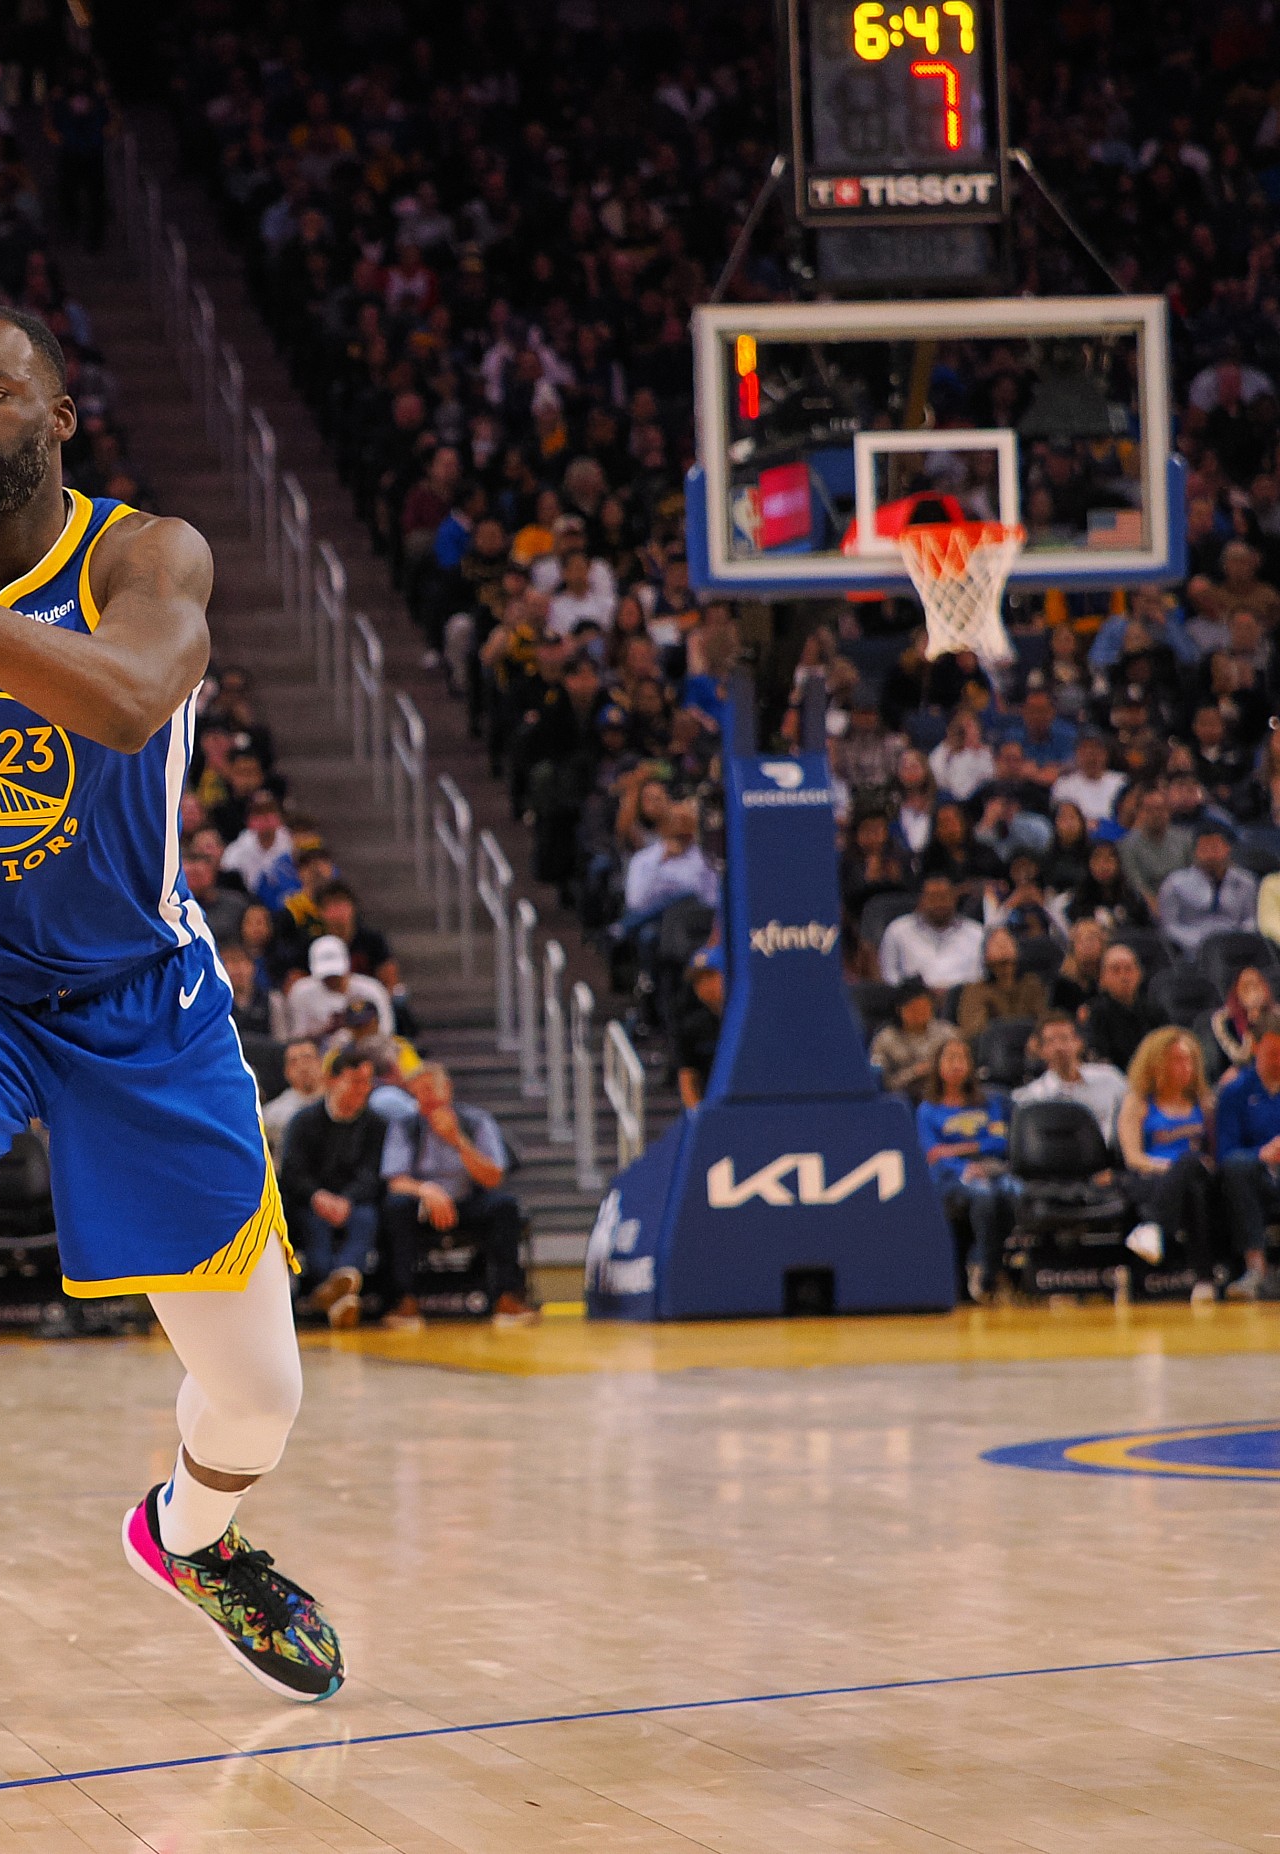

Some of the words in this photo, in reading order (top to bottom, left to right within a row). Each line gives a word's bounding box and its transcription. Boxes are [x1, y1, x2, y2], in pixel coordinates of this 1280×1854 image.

[853, 1, 975, 60] 6:47
[910, 61, 961, 150] 7
[862, 174, 997, 207] TISSOT
[15, 599, 75, 624] kuten
[749, 919, 840, 959] xfinity
